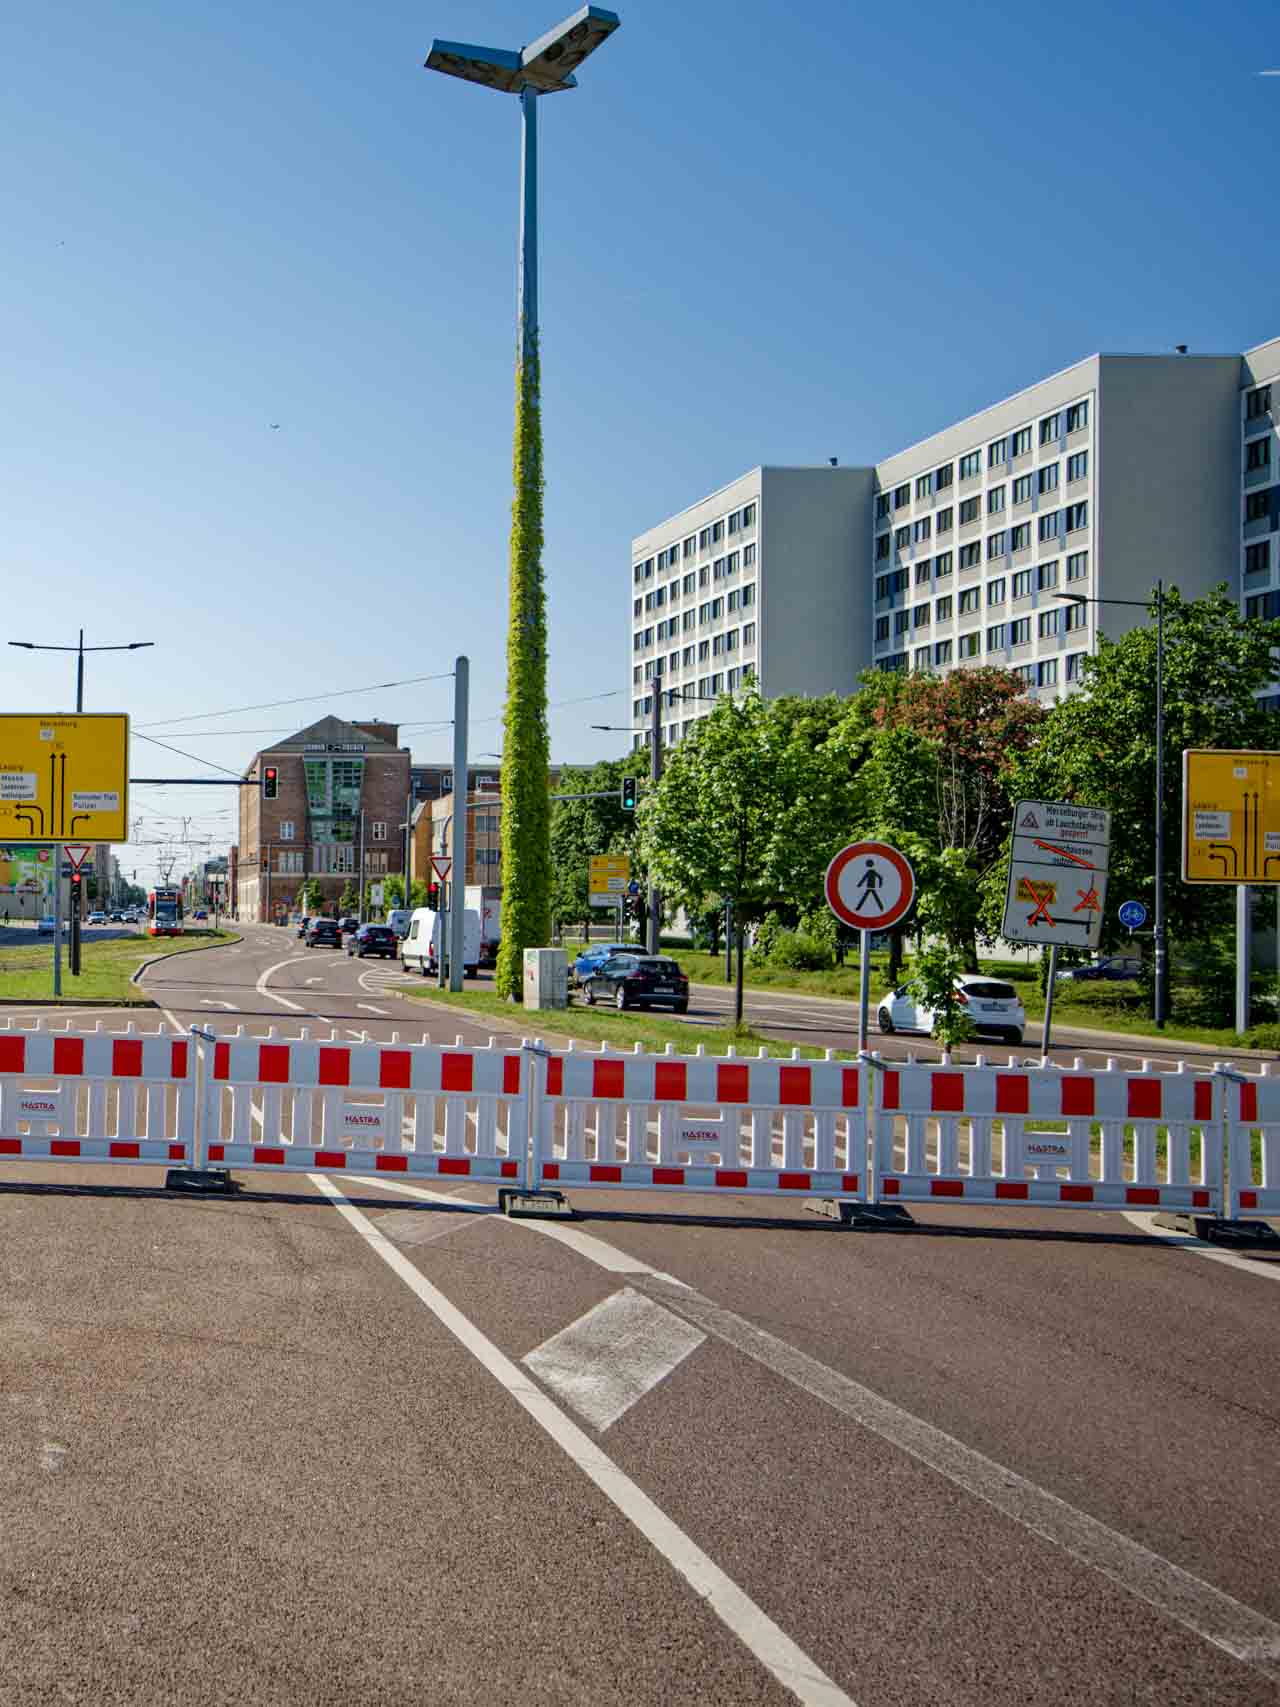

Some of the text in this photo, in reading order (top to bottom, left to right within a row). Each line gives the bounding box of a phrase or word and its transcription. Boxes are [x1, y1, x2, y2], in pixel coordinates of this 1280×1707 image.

[21, 1102, 55, 1111] HASTRA
[345, 1115, 380, 1126] HASTRA
[682, 1131, 719, 1140] HASTRA
[1028, 1143, 1065, 1153] HASTRA
